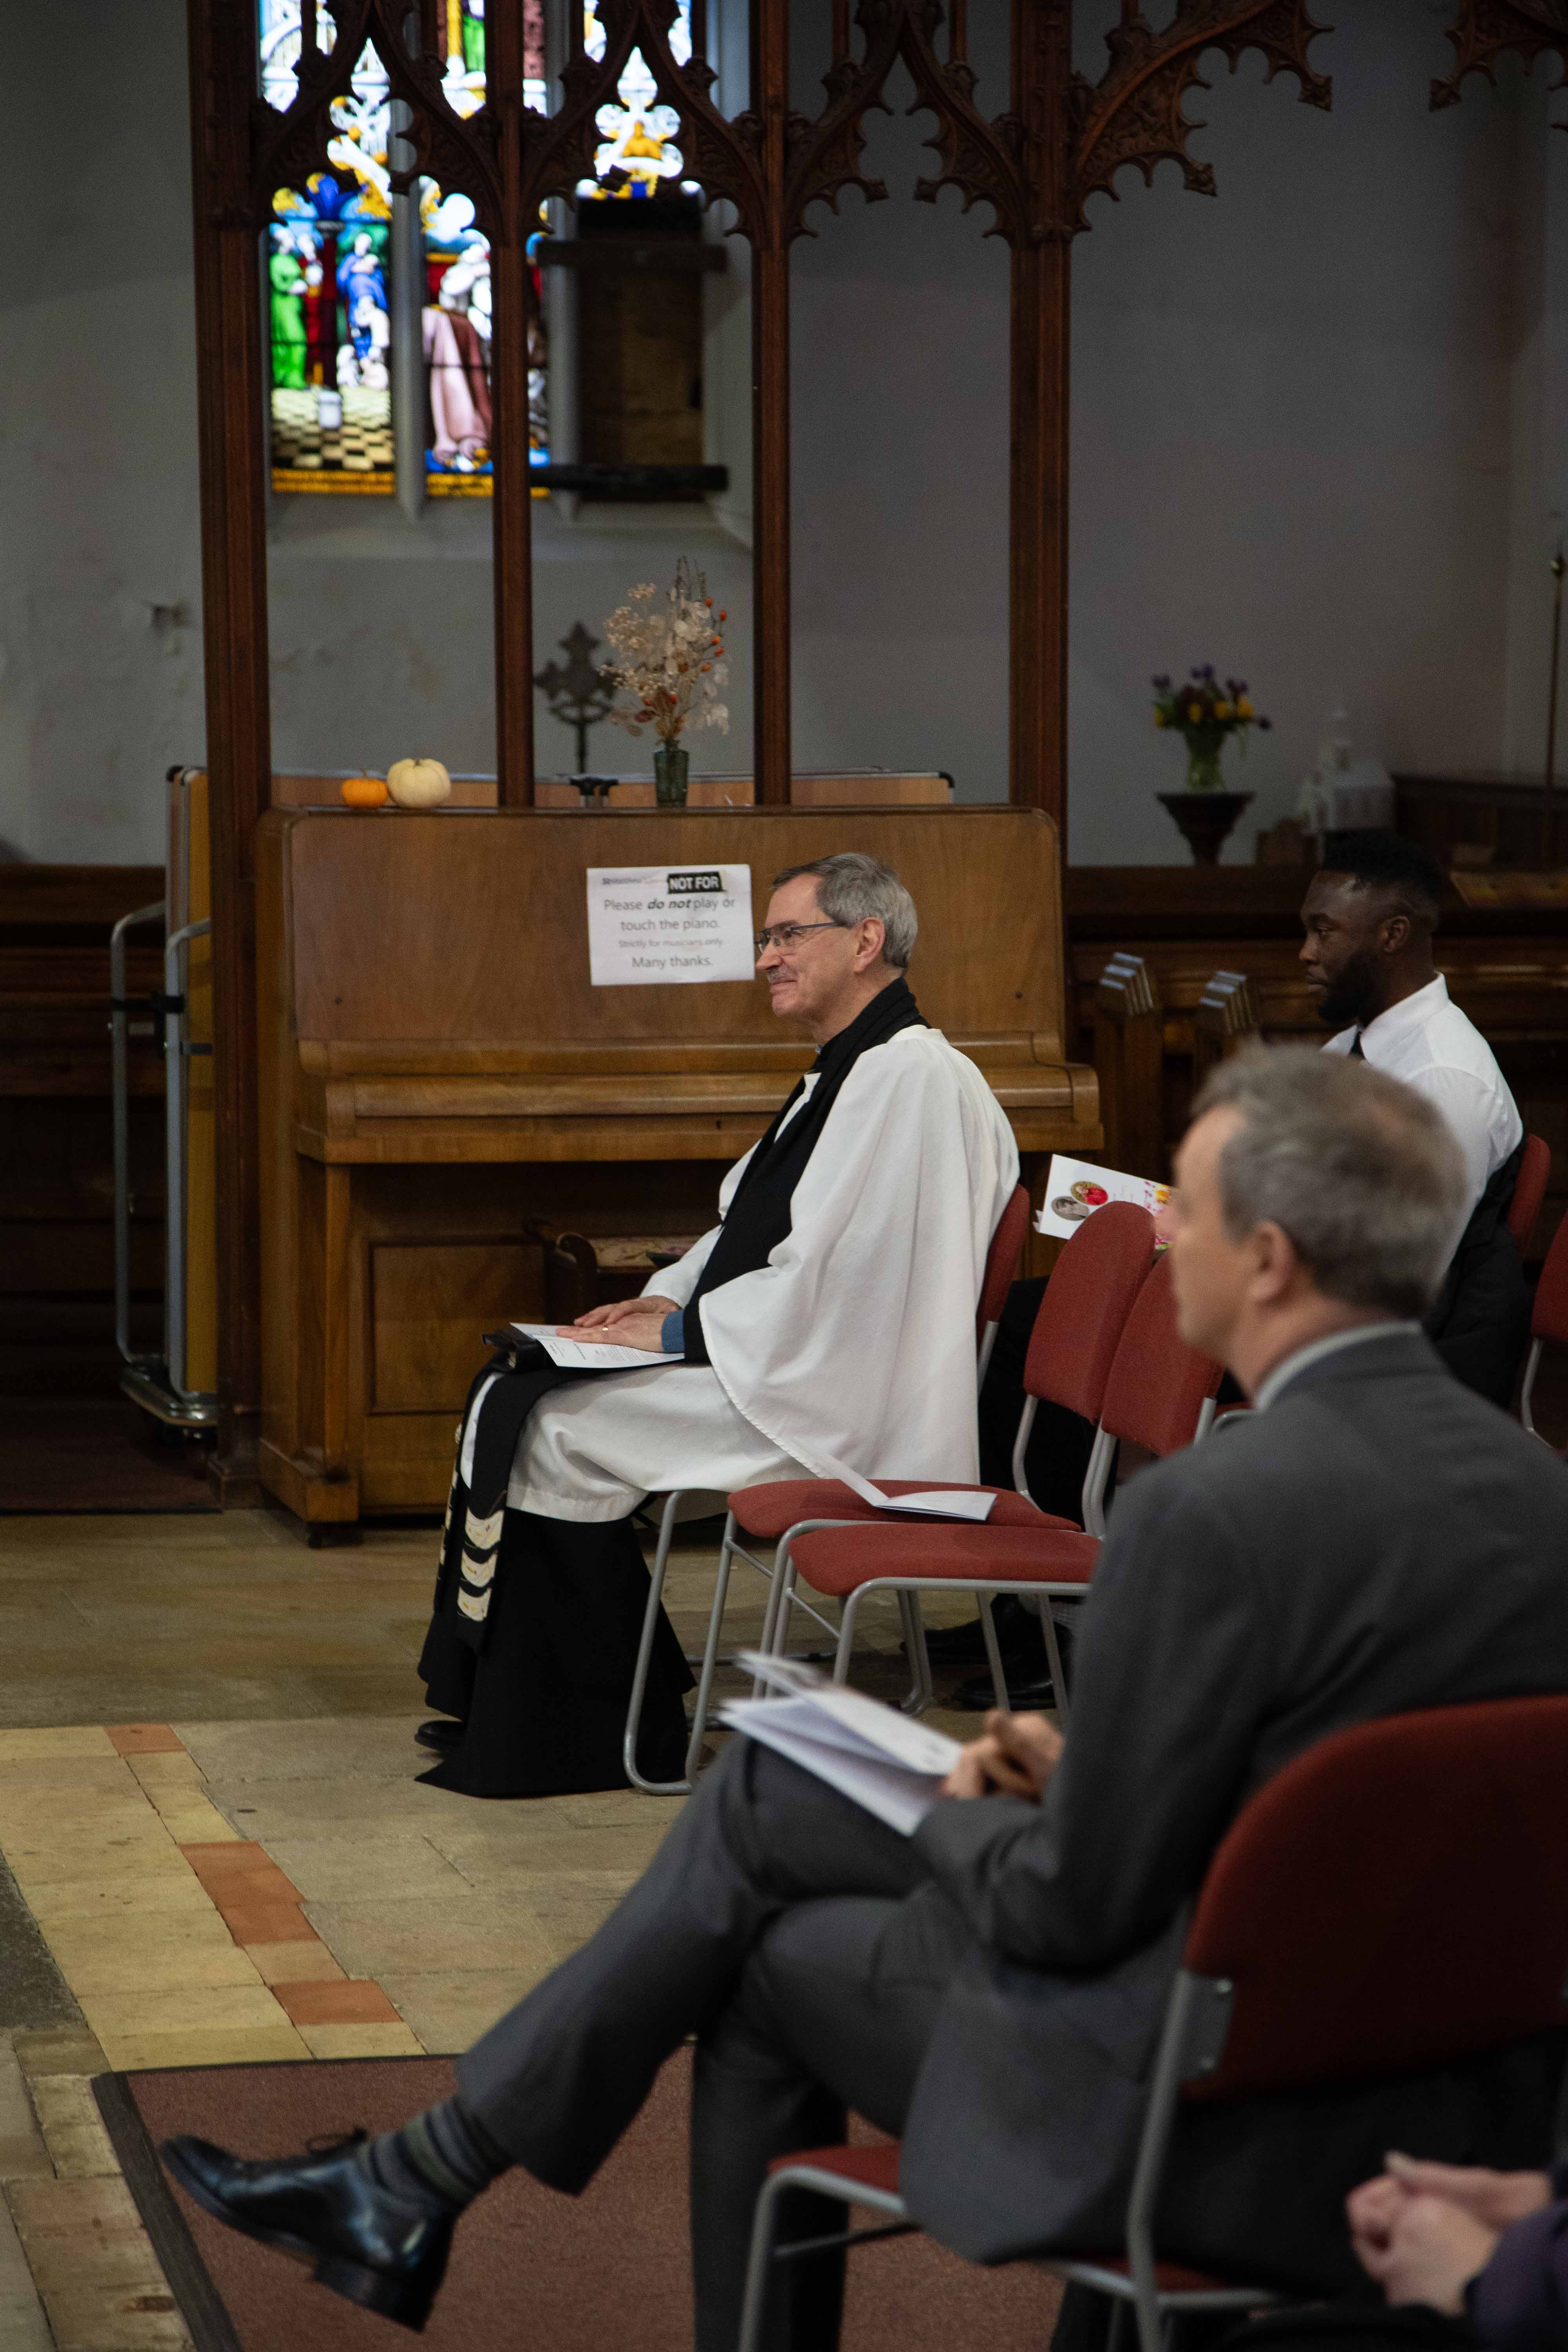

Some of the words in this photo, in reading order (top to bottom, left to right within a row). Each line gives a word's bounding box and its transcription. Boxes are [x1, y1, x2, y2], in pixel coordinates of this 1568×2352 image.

[670, 877, 693, 890] NOT
[695, 876, 719, 889] FOR
[604, 899, 642, 910] Please
[648, 899, 664, 909] do
[668, 899, 691, 909] not
[693, 898, 718, 911] play
[722, 899, 735, 907] or
[621, 920, 655, 931] touch
[659, 920, 680, 929] the
[632, 957, 666, 970] Many
[670, 956, 713, 967] thanks.
